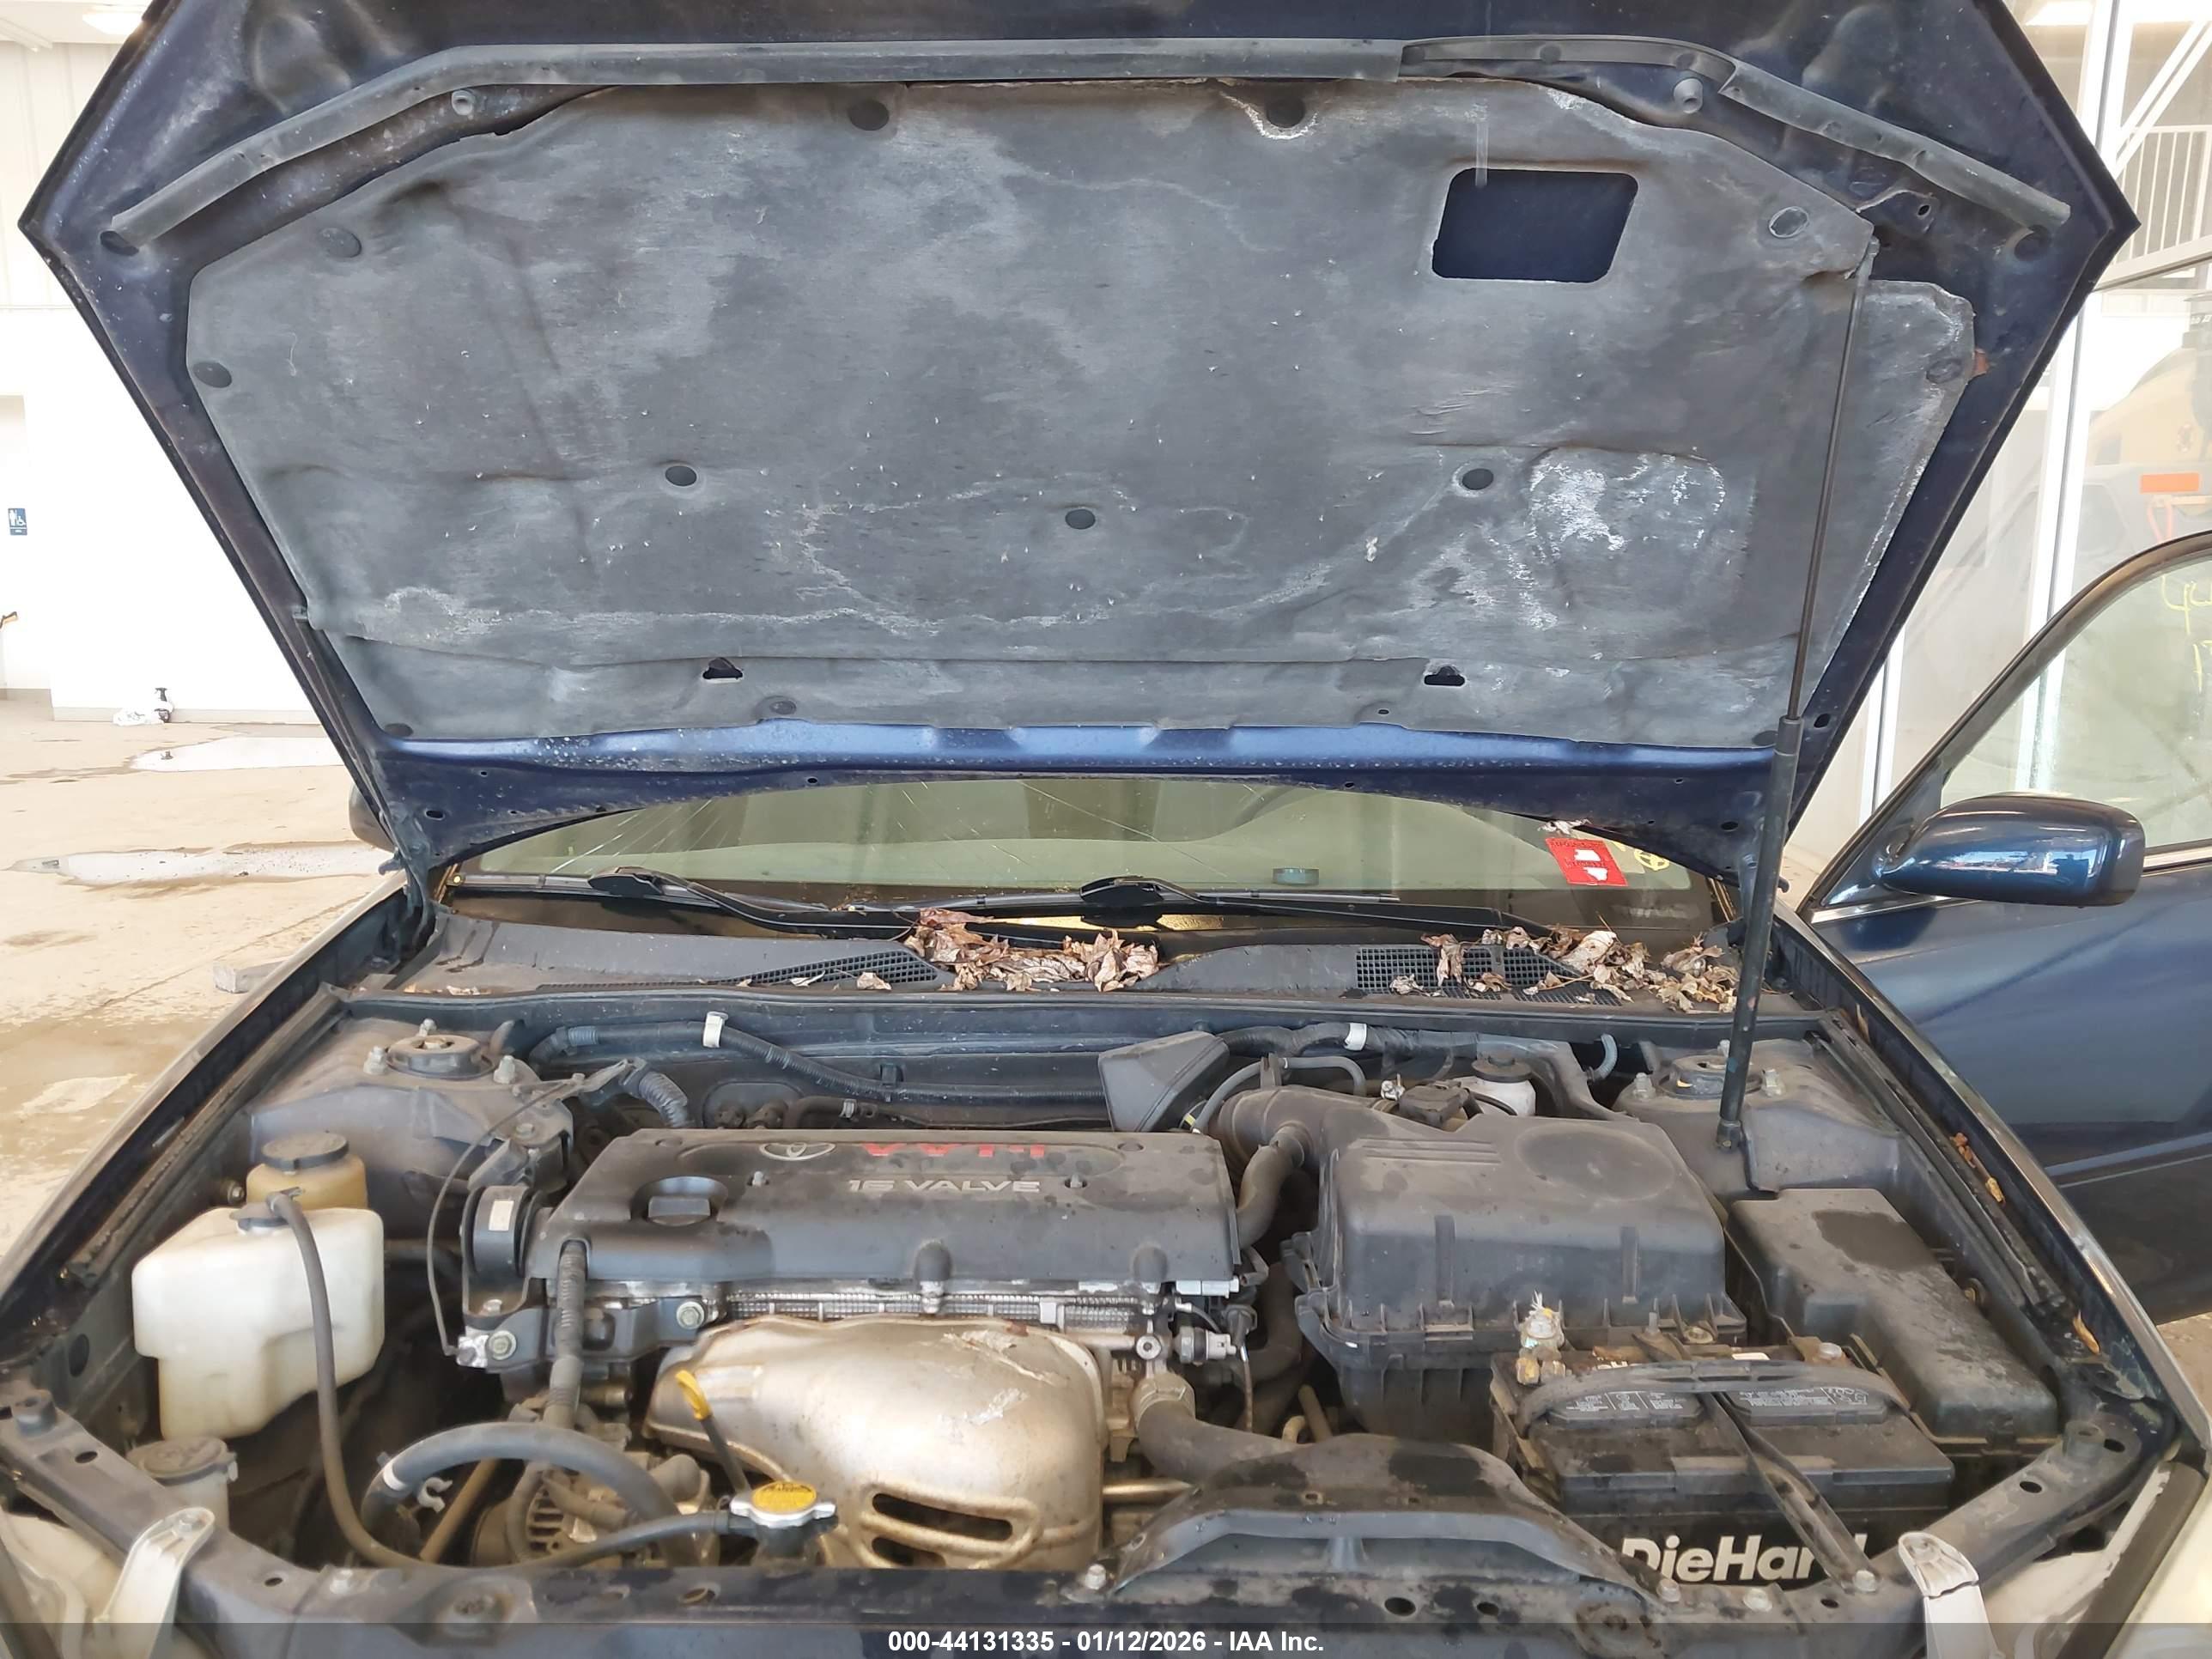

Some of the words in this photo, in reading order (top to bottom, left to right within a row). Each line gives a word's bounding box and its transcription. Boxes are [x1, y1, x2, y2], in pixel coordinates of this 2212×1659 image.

[849, 1180, 895, 1193] 16
[904, 1180, 1040, 1193] VALVE
[1621, 1534, 1868, 1582] DieHar
